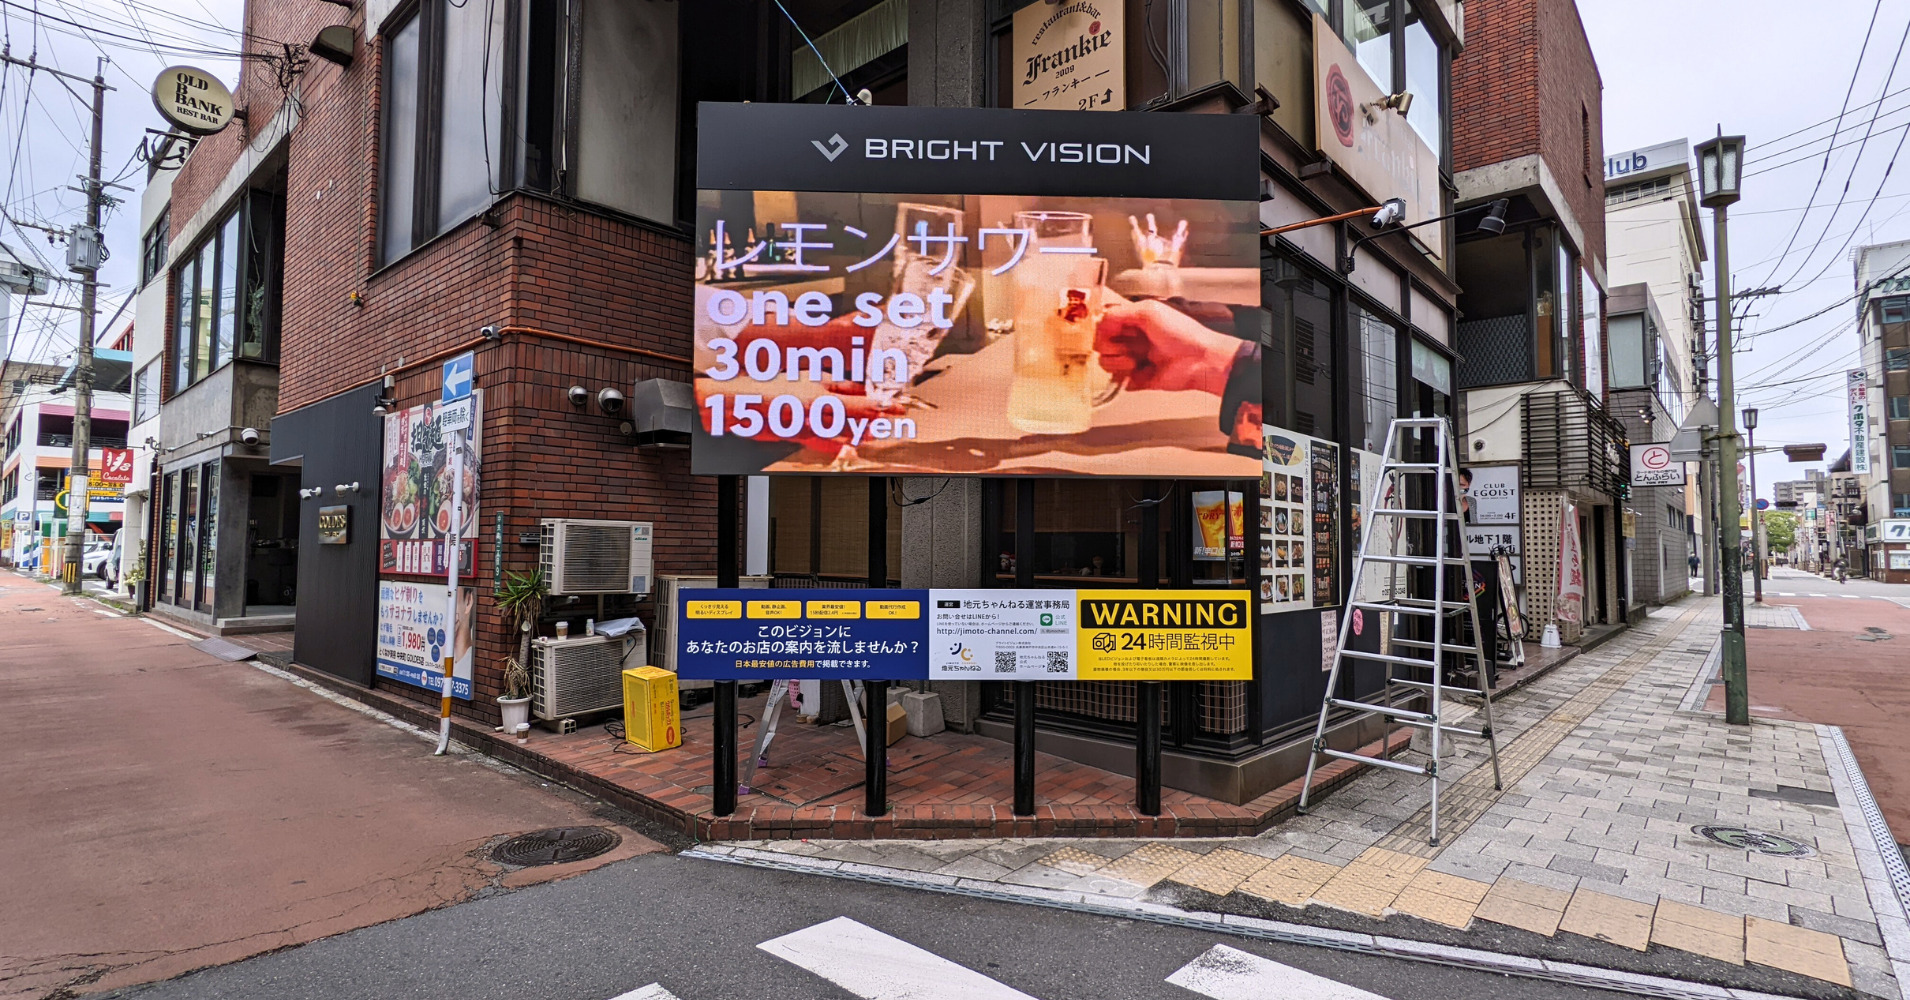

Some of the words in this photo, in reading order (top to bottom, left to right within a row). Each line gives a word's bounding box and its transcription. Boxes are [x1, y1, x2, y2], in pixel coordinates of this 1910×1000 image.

[1022, 30, 1112, 86] Frankie
[176, 72, 208, 90] OLD
[1055, 65, 1075, 79] 2009
[1042, 77, 1090, 100] フランキー
[175, 92, 223, 116] BANK
[1078, 94, 1098, 110] 2F
[176, 106, 199, 118] REST
[200, 113, 218, 124] BAR
[866, 138, 1004, 162] BRIGHT
[1021, 142, 1150, 165] VISION
[1603, 152, 1647, 177] lub
[712, 219, 1098, 276] レモンサワー
[707, 290, 832, 326] one
[854, 286, 953, 329] set
[706, 336, 909, 383] 30min
[704, 394, 916, 446] 1500yen
[1474, 488, 1516, 497] EGOIST
[963, 600, 1070, 609] 地元ちゃんねる運営事務局
[1090, 603, 1238, 626] WARNING
[758, 625, 851, 638] このビジョンに
[937, 628, 1038, 636] http://jimoto-channel.com/
[686, 640, 919, 654] あなたのお店の案内を流しませんか?
[1121, 632, 1235, 651] 24時間監視中
[735, 660, 871, 669] 日本最安値の広告費用で掲載できます。
